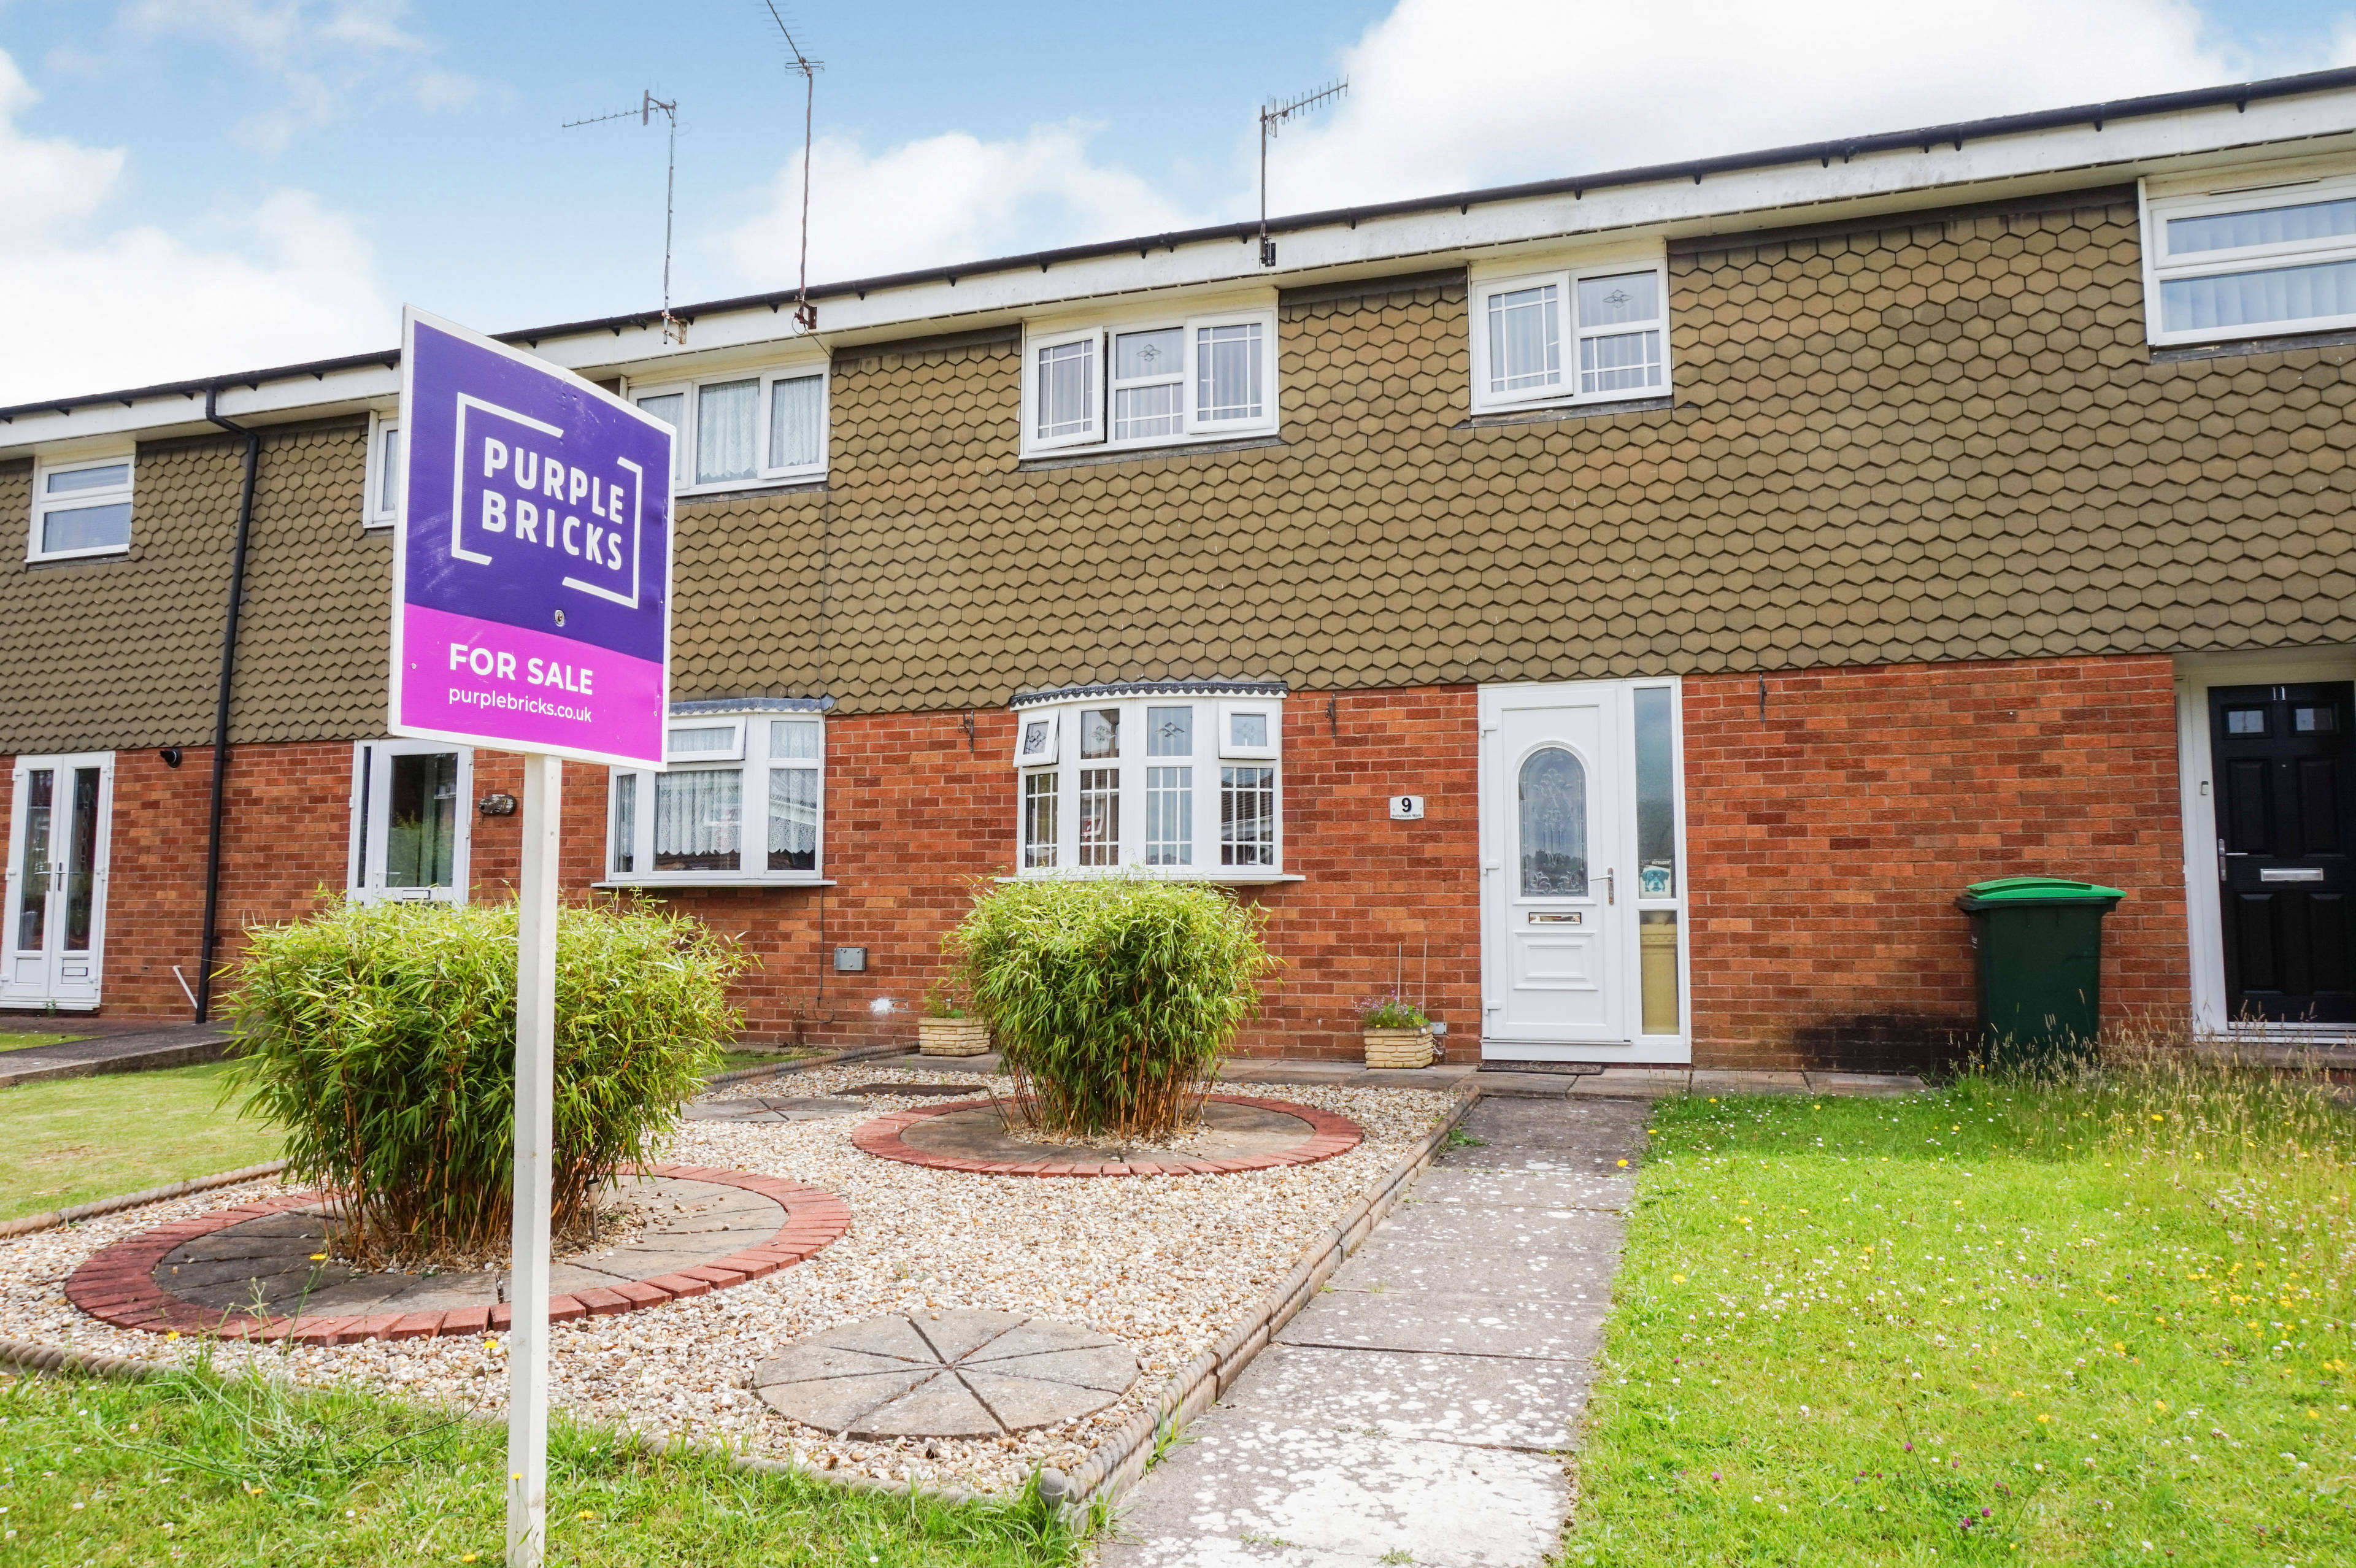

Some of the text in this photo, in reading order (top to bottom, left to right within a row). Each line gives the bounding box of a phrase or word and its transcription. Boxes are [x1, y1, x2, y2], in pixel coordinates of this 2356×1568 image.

[483, 436, 624, 525] PURPLE
[482, 489, 622, 571] BRICKS
[450, 642, 593, 696] FOR SALE
[448, 688, 592, 723] purplebricks.co.uk
[2272, 686, 2287, 701] 11
[1401, 797, 1412, 813] 9
